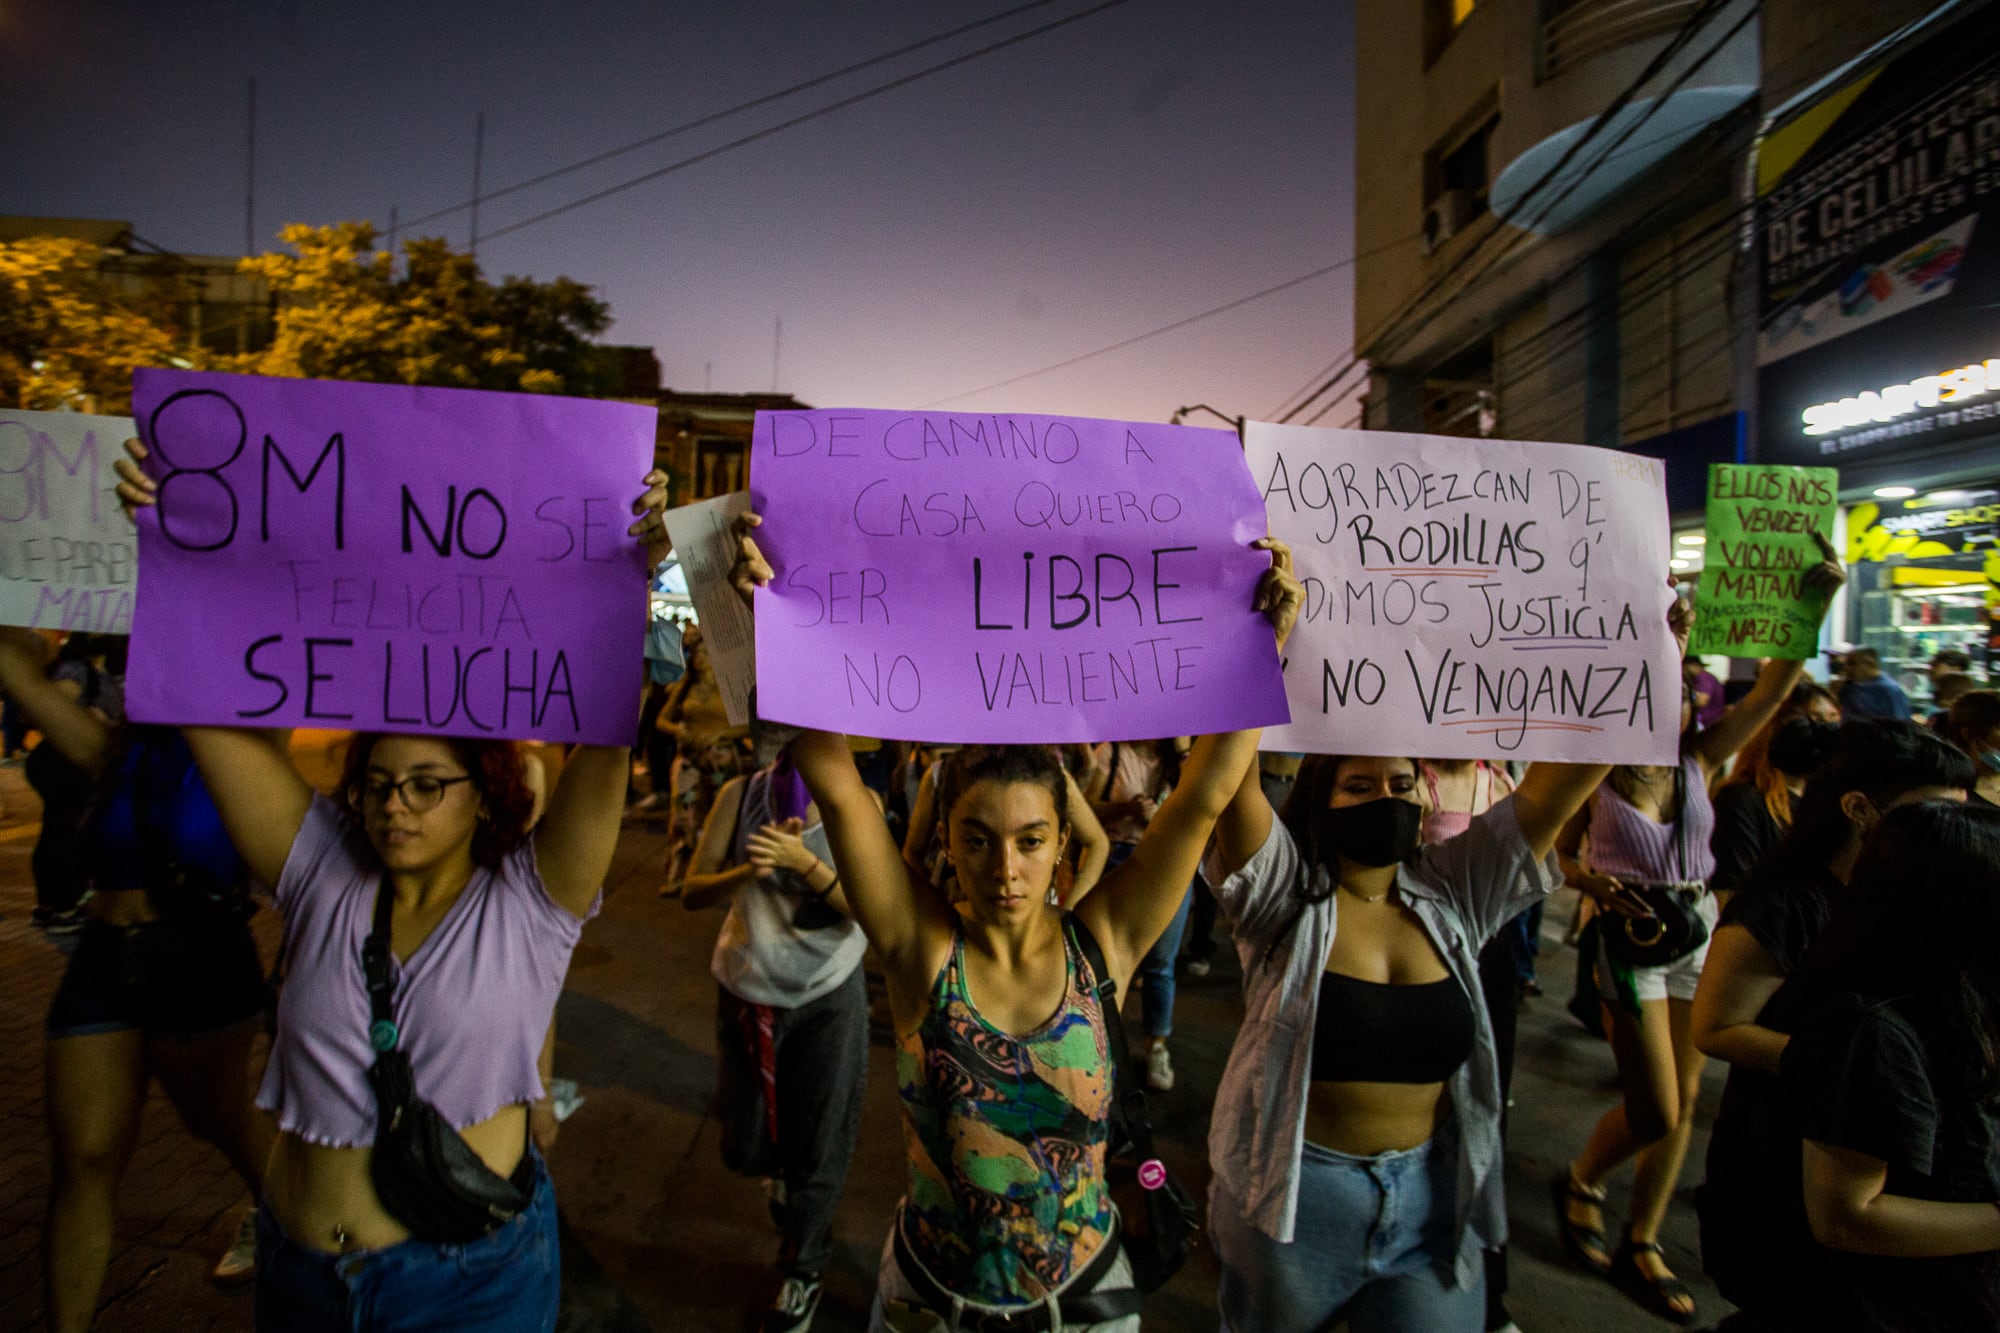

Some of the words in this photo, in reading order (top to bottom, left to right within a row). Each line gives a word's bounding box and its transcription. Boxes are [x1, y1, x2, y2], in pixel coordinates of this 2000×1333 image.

[1768, 207, 1809, 263] DE
[771, 413, 863, 459] DE
[884, 414, 1080, 464] CAMINO
[1124, 429, 1154, 464] A
[149, 388, 345, 552] 8M
[401, 483, 507, 560] NO
[535, 495, 613, 563] SE
[1549, 469, 1606, 527] DE
[1713, 467, 1783, 501] ELLOS
[1788, 477, 1833, 507] NOS
[853, 478, 986, 537] CASA
[1014, 480, 1182, 530] QUIERO
[1736, 506, 1819, 535] VENDEN
[51, 536, 131, 586] PARE
[1347, 512, 1546, 574] RODILLAS
[1720, 540, 1805, 571] VIOLAN
[277, 559, 531, 640] FELICITA
[787, 563, 891, 629] SER
[1302, 576, 1450, 627] DIMOS
[1714, 571, 1802, 601] MATAN
[1726, 617, 1793, 647] NAZIS
[236, 634, 354, 719] SE
[383, 640, 580, 732] LUCHA
[843, 651, 921, 713] NO
[975, 637, 1203, 711] VALIENTE
[1322, 657, 1387, 715] NO
